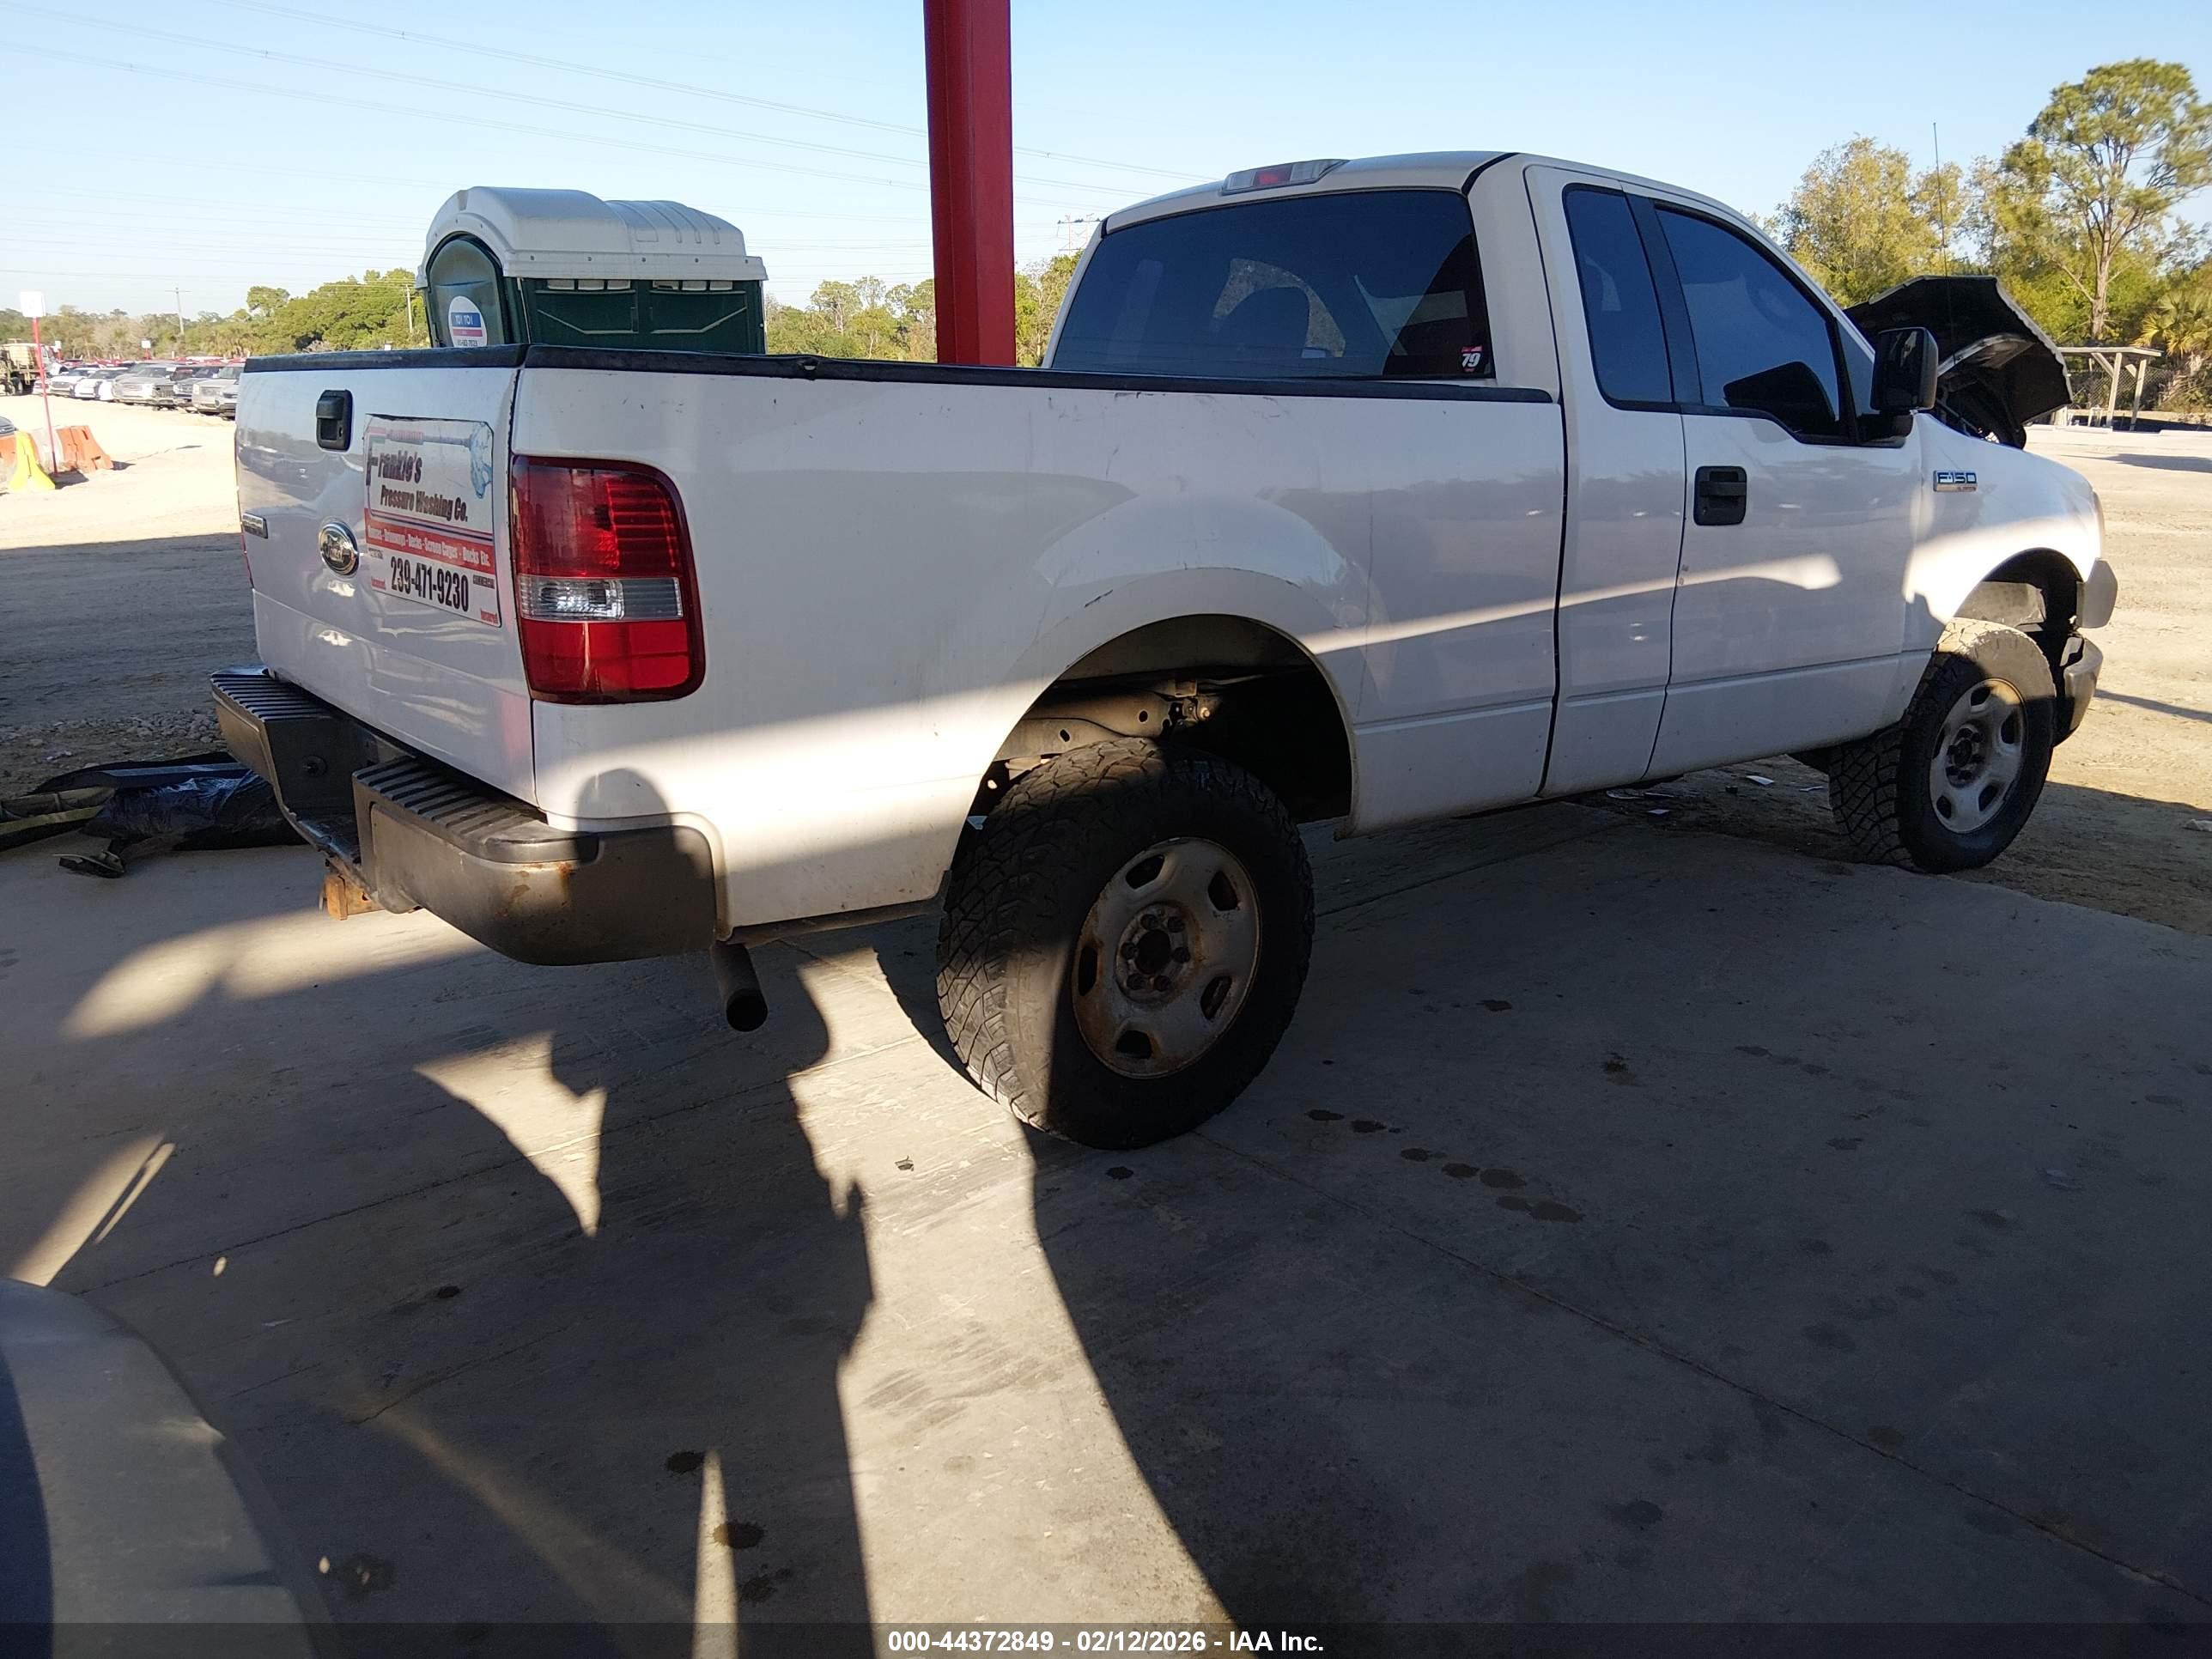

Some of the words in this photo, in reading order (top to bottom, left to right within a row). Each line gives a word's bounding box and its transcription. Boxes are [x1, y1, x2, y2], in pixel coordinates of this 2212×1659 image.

[1462, 352, 1481, 368] 79
[366, 434, 423, 486] Frankie's
[380, 485, 415, 512] Pressure
[416, 490, 453, 522] Washing
[454, 496, 468, 522] Co.
[391, 556, 469, 612] 239-471-9230
